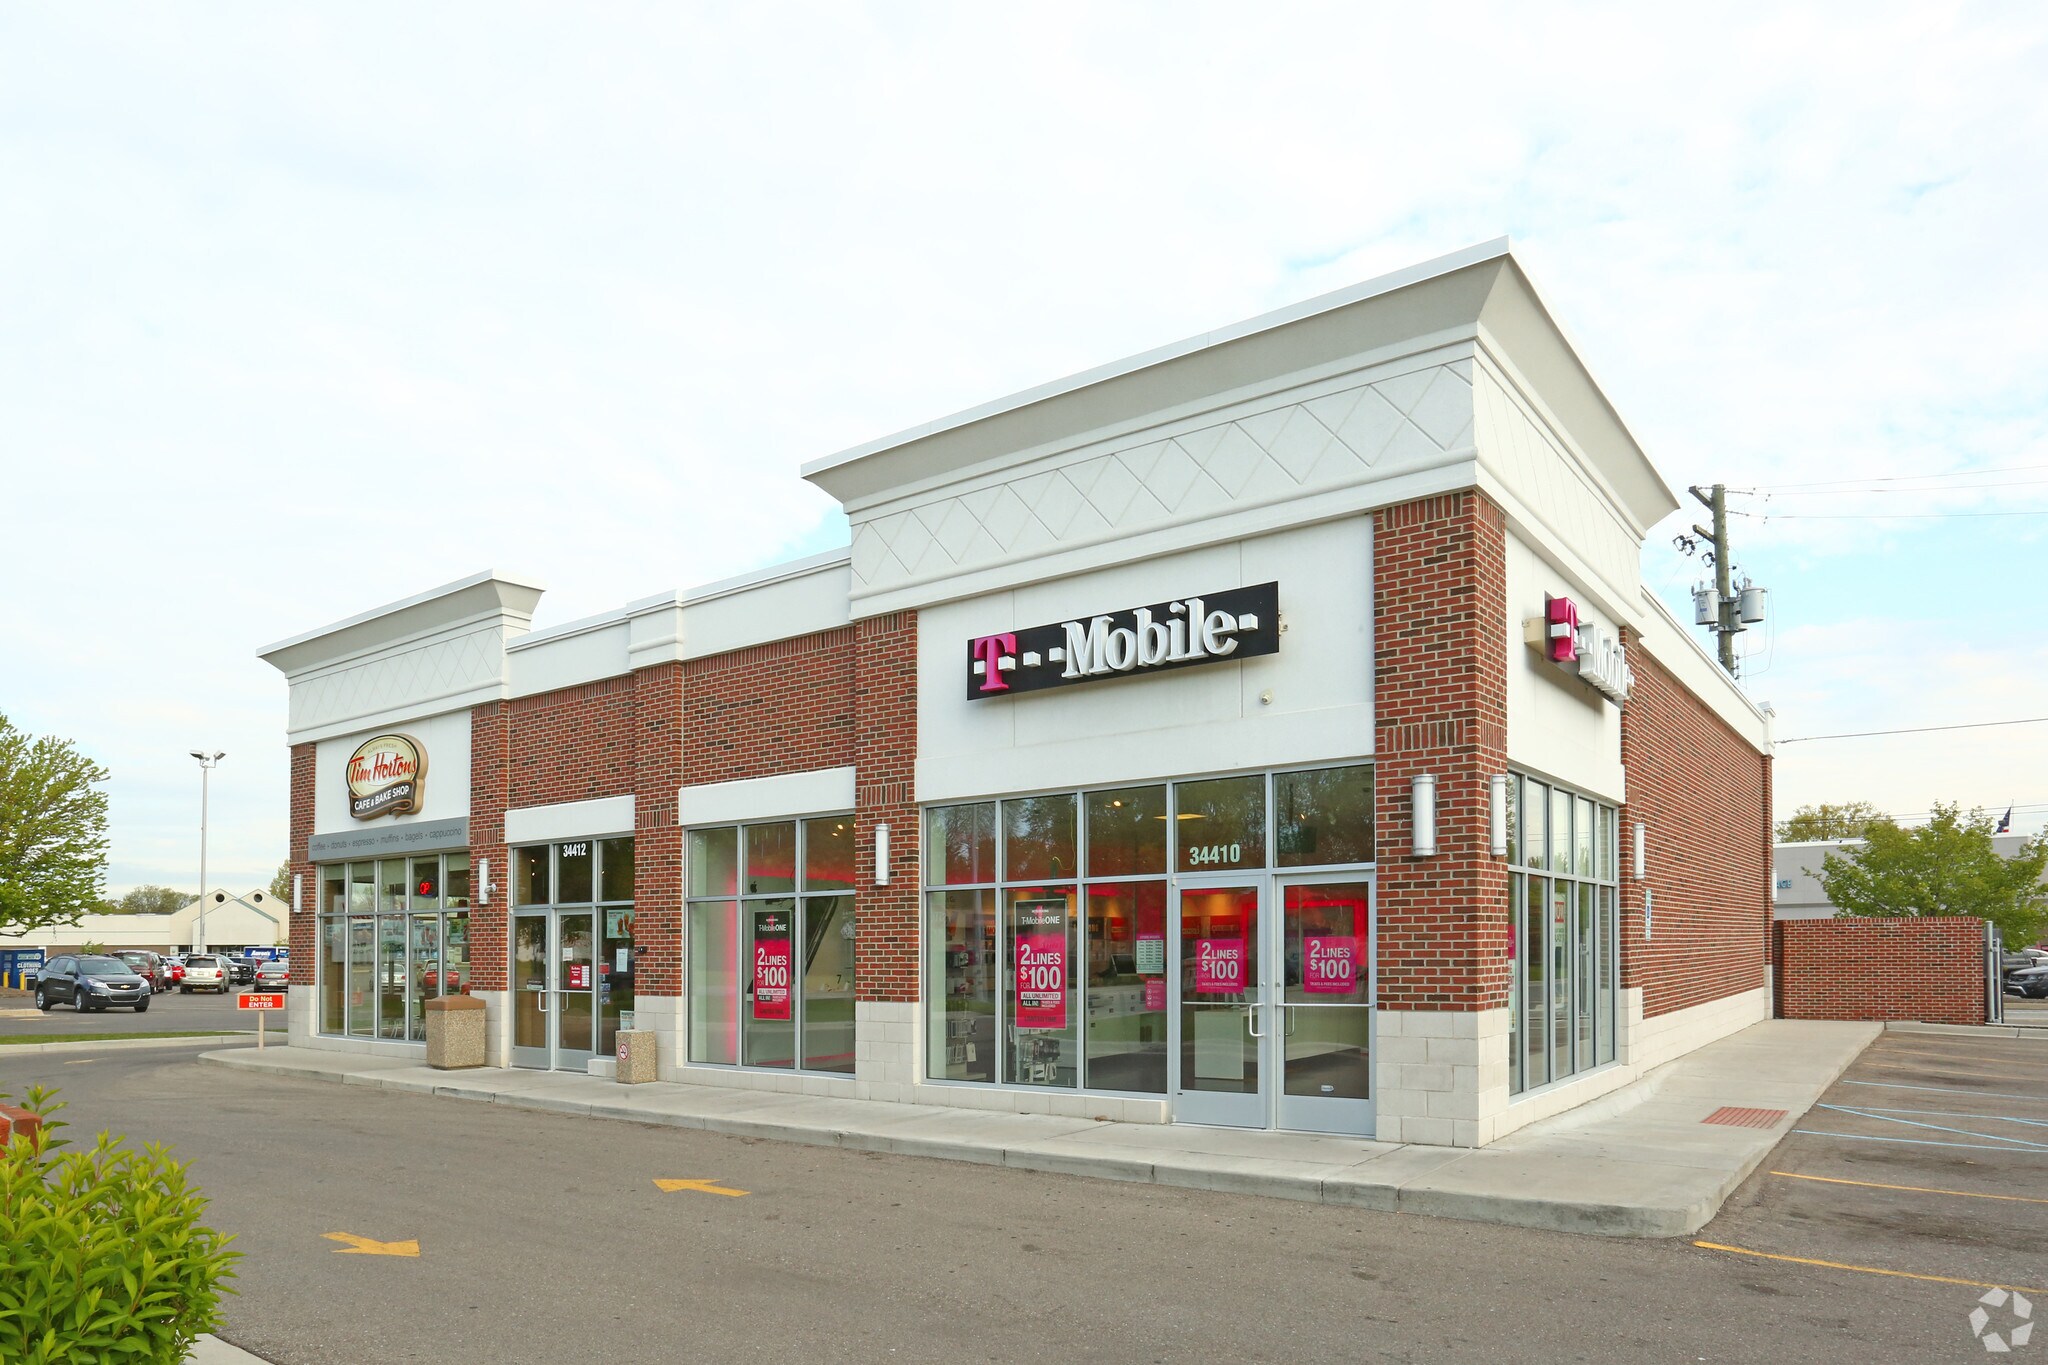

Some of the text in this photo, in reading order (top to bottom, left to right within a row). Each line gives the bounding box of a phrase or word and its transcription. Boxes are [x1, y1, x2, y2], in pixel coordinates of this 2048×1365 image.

[350, 752, 416, 784] Tim Hortons
[354, 799, 371, 811] CAFE
[375, 789, 392, 805] BAKE
[392, 785, 410, 798] SHOP
[331, 840, 347, 850] donuts
[352, 838, 375, 848] espresso
[380, 834, 400, 844] muffins
[405, 831, 424, 843] bagels
[429, 828, 462, 840] cappuccino
[563, 842, 586, 857] 34412
[1189, 843, 1240, 865] 34410
[757, 948, 787, 965] 2 LINES
[1020, 943, 1062, 965] 2 LINES
[1201, 942, 1239, 960] 2 LINES
[1310, 940, 1351, 958] 2 LINES
[757, 966, 787, 987] $100
[1020, 965, 1062, 990] $100
[1201, 960, 1239, 980] $100
[1310, 959, 1350, 979] $100
